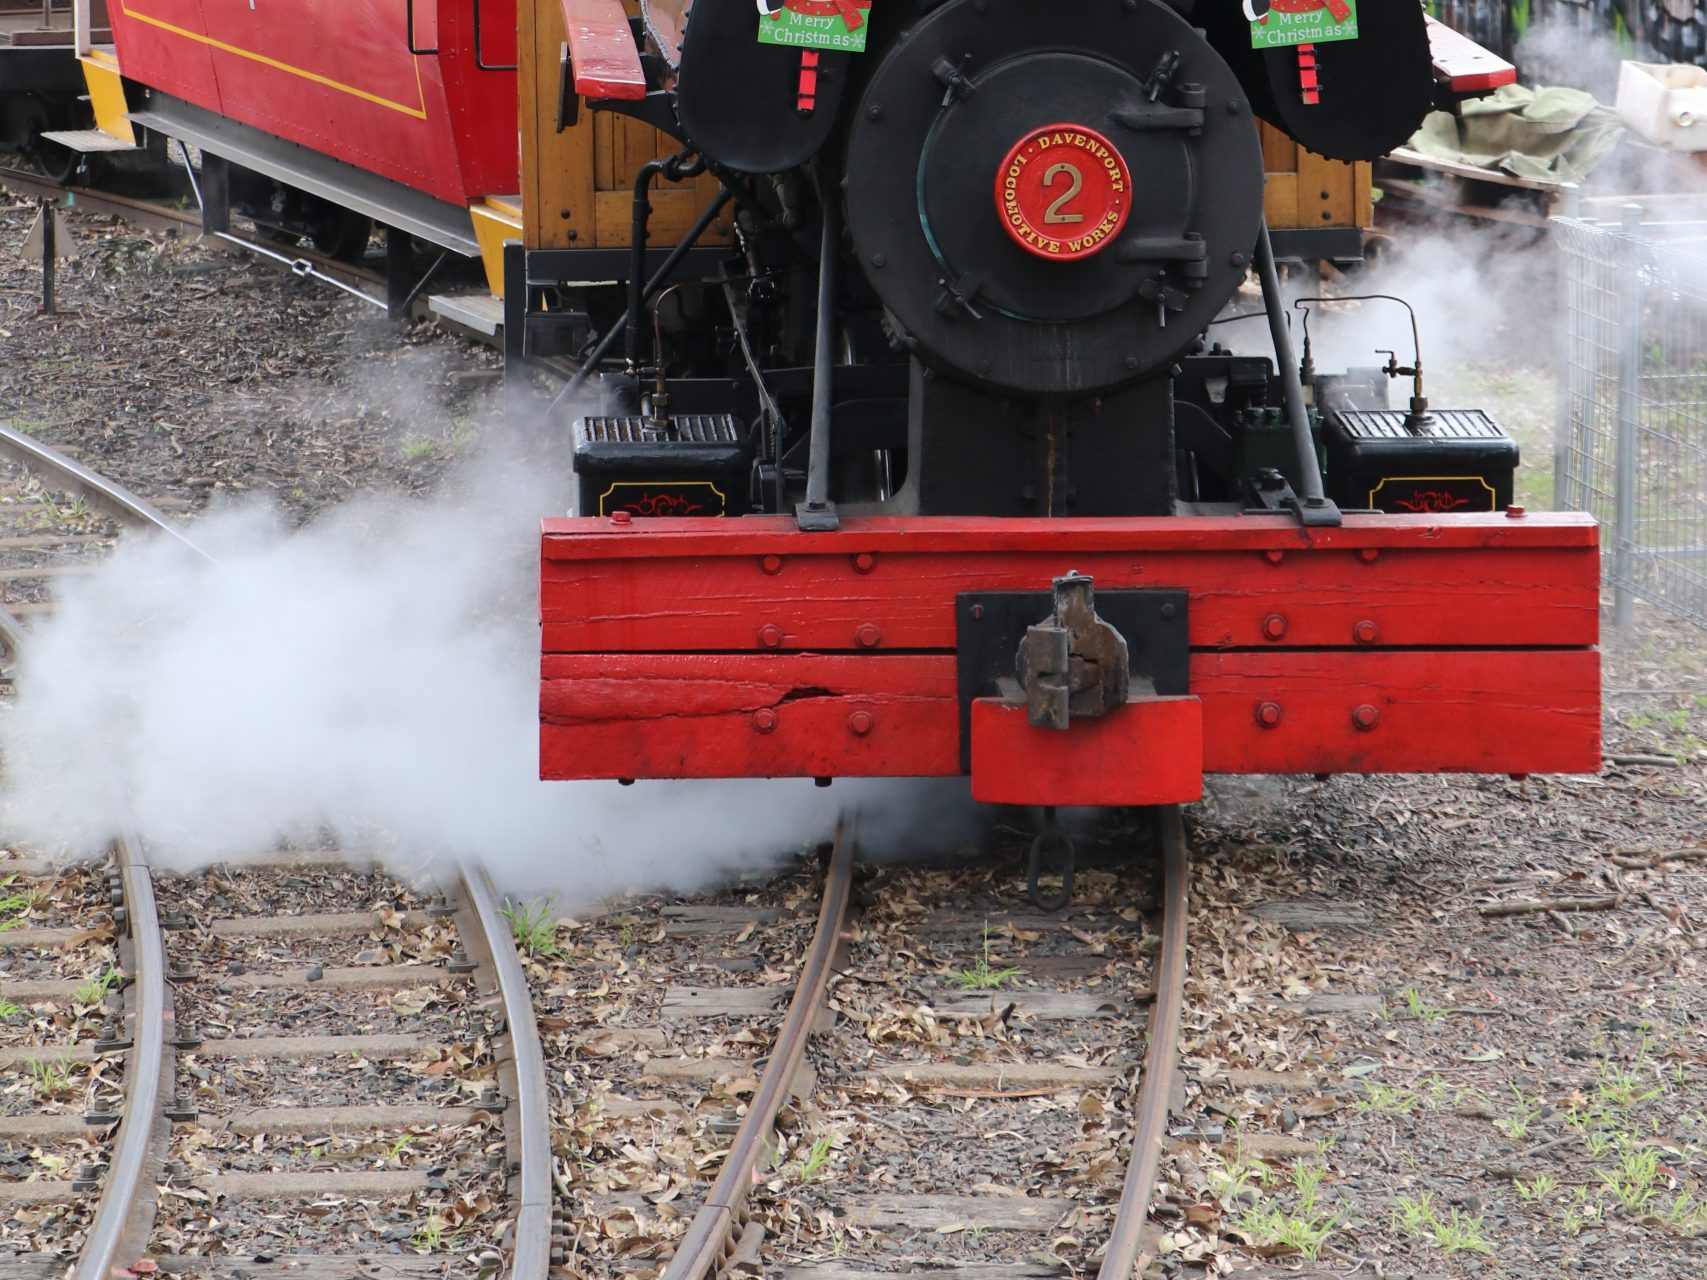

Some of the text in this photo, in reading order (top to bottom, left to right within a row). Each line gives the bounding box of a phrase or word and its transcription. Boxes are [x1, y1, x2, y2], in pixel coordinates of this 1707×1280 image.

[789, 11, 834, 29] Merry
[1279, 11, 1323, 26] Merry
[774, 28, 850, 46] Christmas
[1267, 24, 1342, 45] Christmas
[1038, 133, 1124, 193] DAVENPORT
[1005, 153, 1119, 253] LOCOMOTIVE WORKS
[1043, 162, 1084, 224] 2
